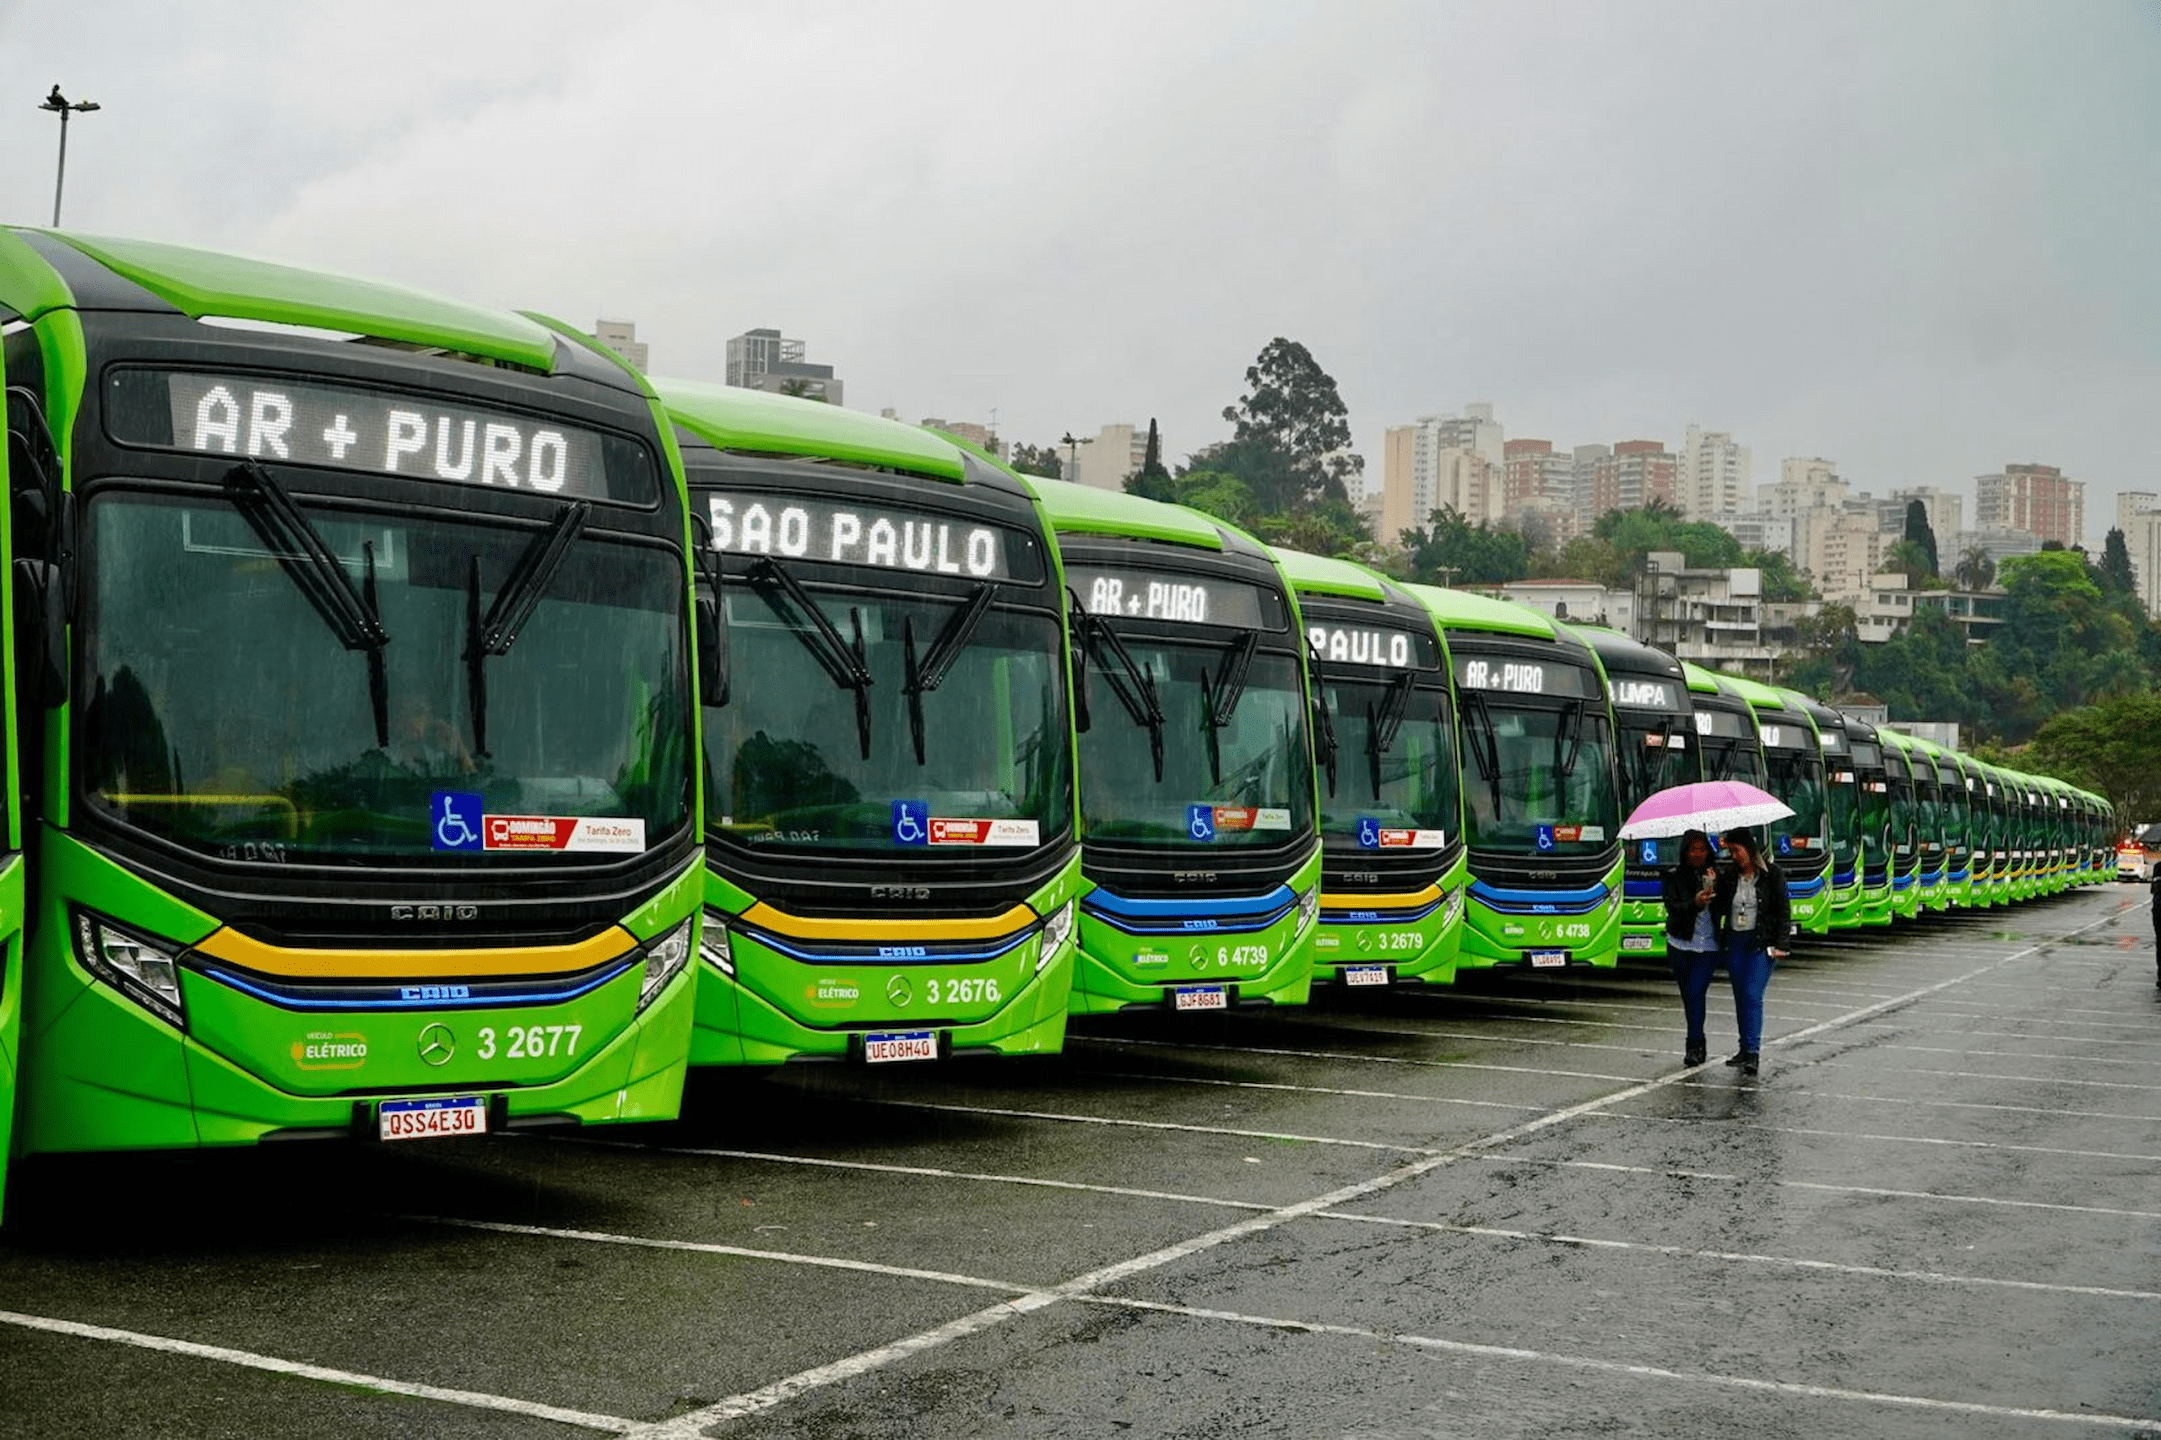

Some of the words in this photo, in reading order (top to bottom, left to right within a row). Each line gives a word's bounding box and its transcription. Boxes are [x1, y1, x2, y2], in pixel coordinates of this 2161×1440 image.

[194, 385, 292, 459] AR
[323, 414, 357, 460] +
[384, 409, 568, 493] PURO
[709, 498, 809, 557] SAO
[831, 512, 995, 577] PAULO
[1090, 576, 1122, 616] AR
[1127, 594, 1142, 616] +
[1147, 581, 1207, 623] PURO
[1309, 627, 1408, 668] PAULO
[1466, 660, 1488, 689] AR
[1490, 672, 1500, 688] +
[1503, 663, 1544, 693] PURO
[1619, 682, 1667, 706] LIMPA
[585, 825, 610, 836] Tarifa
[611, 826, 633, 836] Zero
[871, 886, 930, 899] CAIO
[391, 905, 478, 920] CAIO
[1379, 933, 1388, 950] 3
[1391, 932, 1423, 949] 2679
[1556, 923, 1564, 938] 6
[1565, 923, 1590, 938] 4738
[879, 946, 926, 957] CAIO
[1217, 947, 1228, 967] 6
[1232, 945, 1268, 965] 4739
[400, 985, 470, 1000] CAIO
[817, 986, 860, 999] ELÉTRICO
[927, 979, 940, 1004] 3
[946, 978, 998, 1003] 2676
[305, 1041, 367, 1059] ELÉTRICO
[477, 1027, 496, 1060] 3
[506, 1024, 582, 1058] 2677
[390, 1109, 475, 1135] QSS4E30
